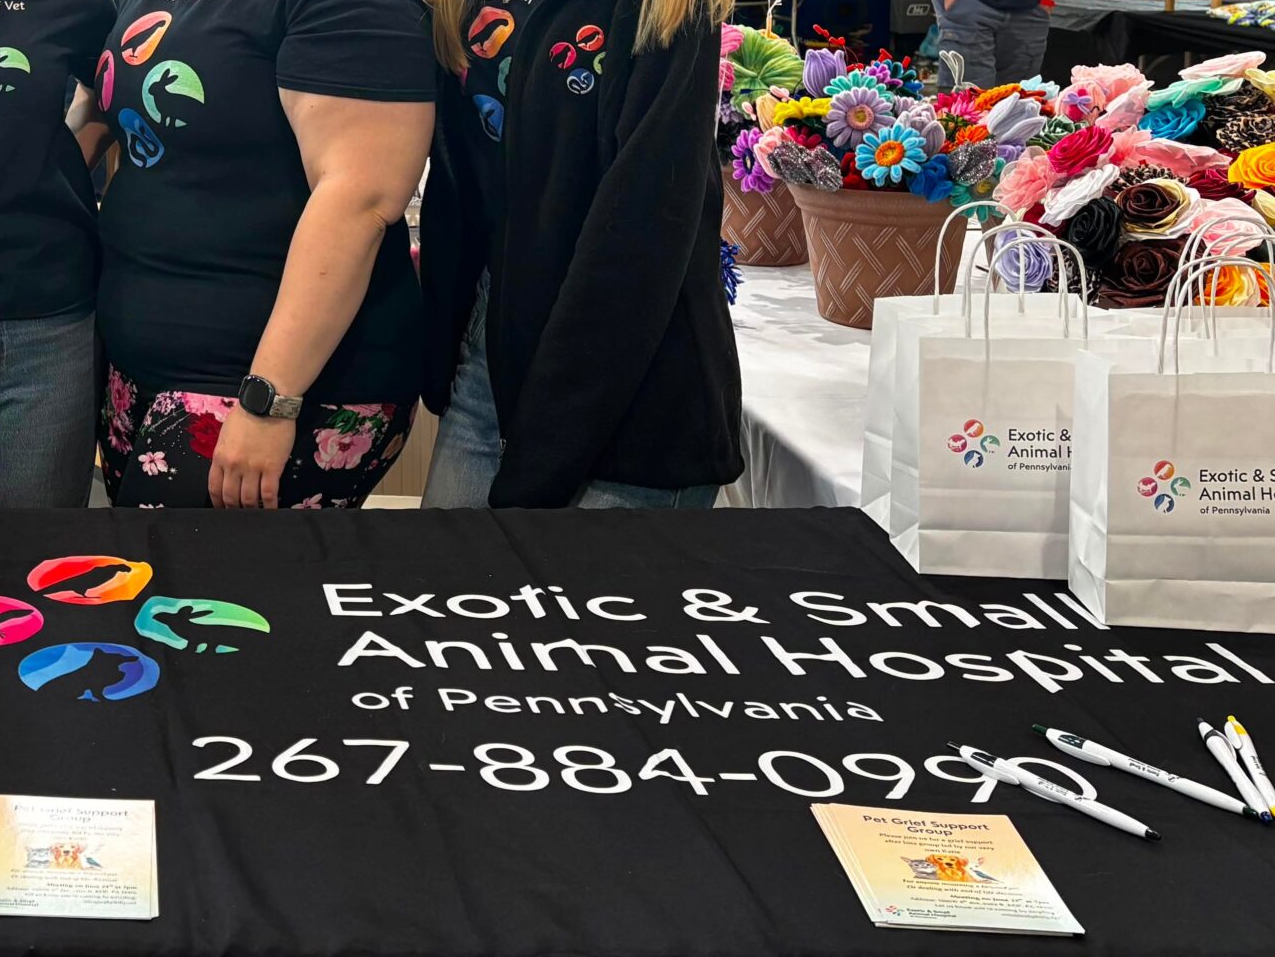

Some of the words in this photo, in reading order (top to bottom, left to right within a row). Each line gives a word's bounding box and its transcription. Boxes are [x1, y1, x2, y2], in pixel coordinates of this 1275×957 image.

[4, 0, 25, 11] Vet
[1008, 428, 1055, 442] Exotic
[1059, 428, 1071, 442] &
[1007, 444, 1062, 458] Animal
[1007, 462, 1017, 470] of
[1019, 462, 1072, 472] Pennsylvani
[1199, 468, 1248, 483] Exotic
[1252, 468, 1265, 483] &
[1199, 485, 1256, 501] Animal
[1199, 506, 1209, 514] of
[1212, 506, 1271, 516] Pennsylvania
[322, 583, 647, 621] Exotic
[681, 587, 771, 624] &
[789, 591, 1111, 631] Small
[337, 630, 741, 676] Animal
[760, 635, 1275, 694] Hospital
[351, 686, 414, 710] of
[437, 687, 885, 725] Pennsylvania
[191, 735, 1098, 804] 267-884-0990
[76, 808, 129, 817] Support
[862, 814, 888, 825] Pet
[891, 817, 927, 827] Grief
[930, 821, 990, 832] Support
[907, 826, 953, 837] Group
